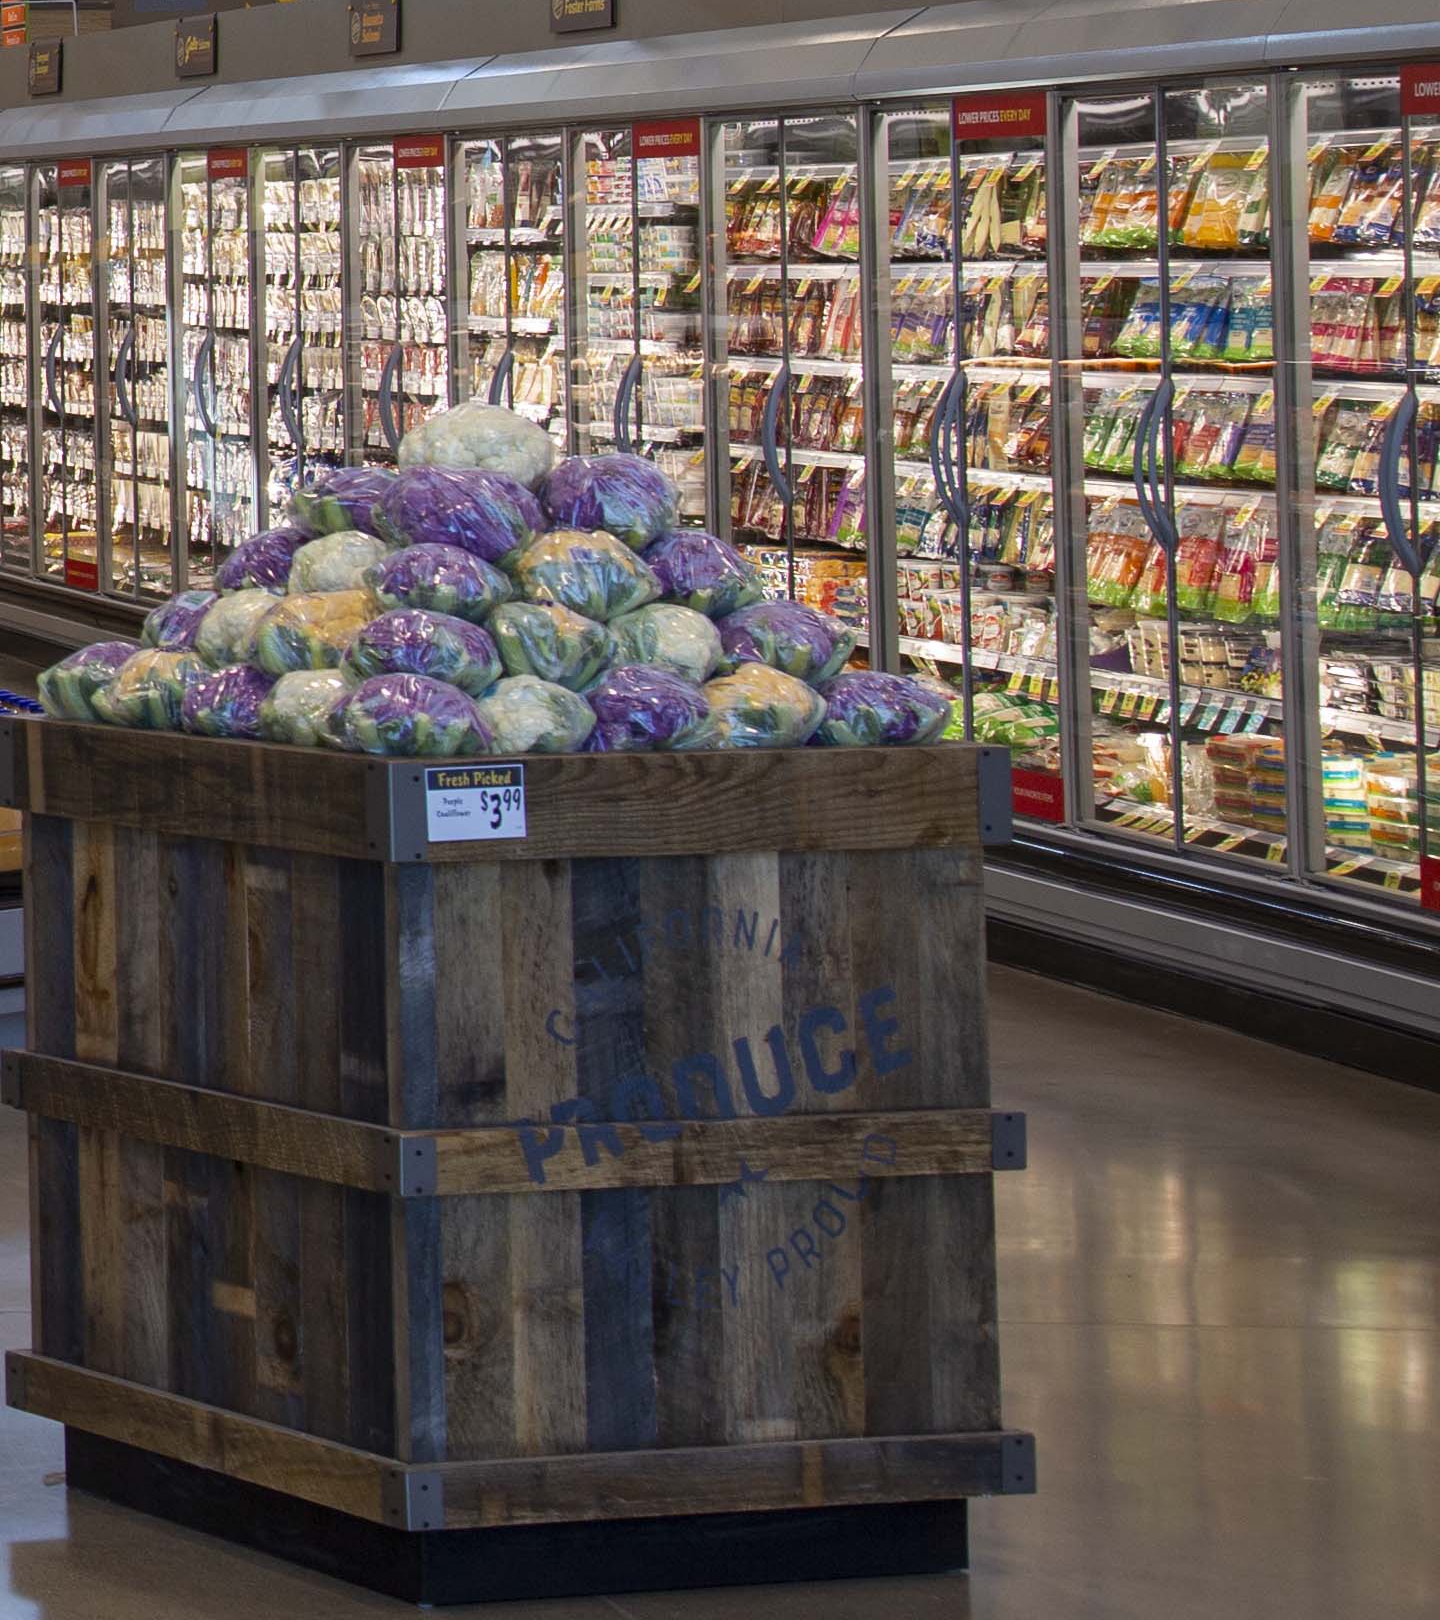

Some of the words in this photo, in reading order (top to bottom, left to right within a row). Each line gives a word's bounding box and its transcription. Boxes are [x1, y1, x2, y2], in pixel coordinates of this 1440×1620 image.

[437, 773, 470, 787] Fresh
[473, 770, 512, 785] Picked
[510, 986, 913, 1185] PRODUCE
[765, 1133, 897, 1288] PROUD
